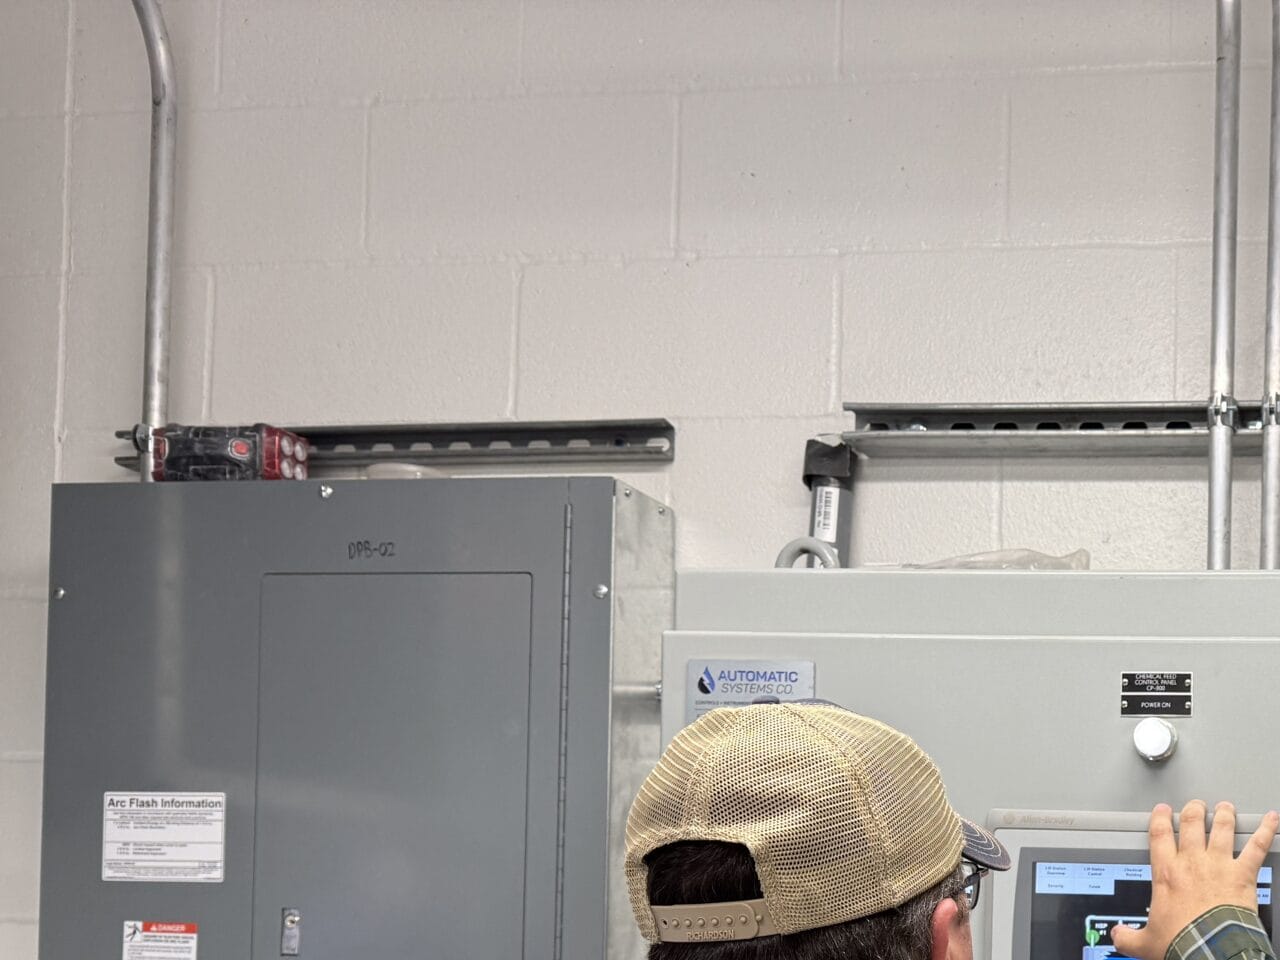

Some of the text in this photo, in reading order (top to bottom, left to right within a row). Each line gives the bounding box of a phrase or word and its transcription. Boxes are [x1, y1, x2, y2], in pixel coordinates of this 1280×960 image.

[348, 540, 396, 560] DPB-02
[718, 670, 798, 682] AUTOMATIC
[721, 683, 794, 694] SYSTEMS CO.
[107, 798, 222, 809] Arc Flash Information
[686, 930, 735, 940] RICHARDSON
